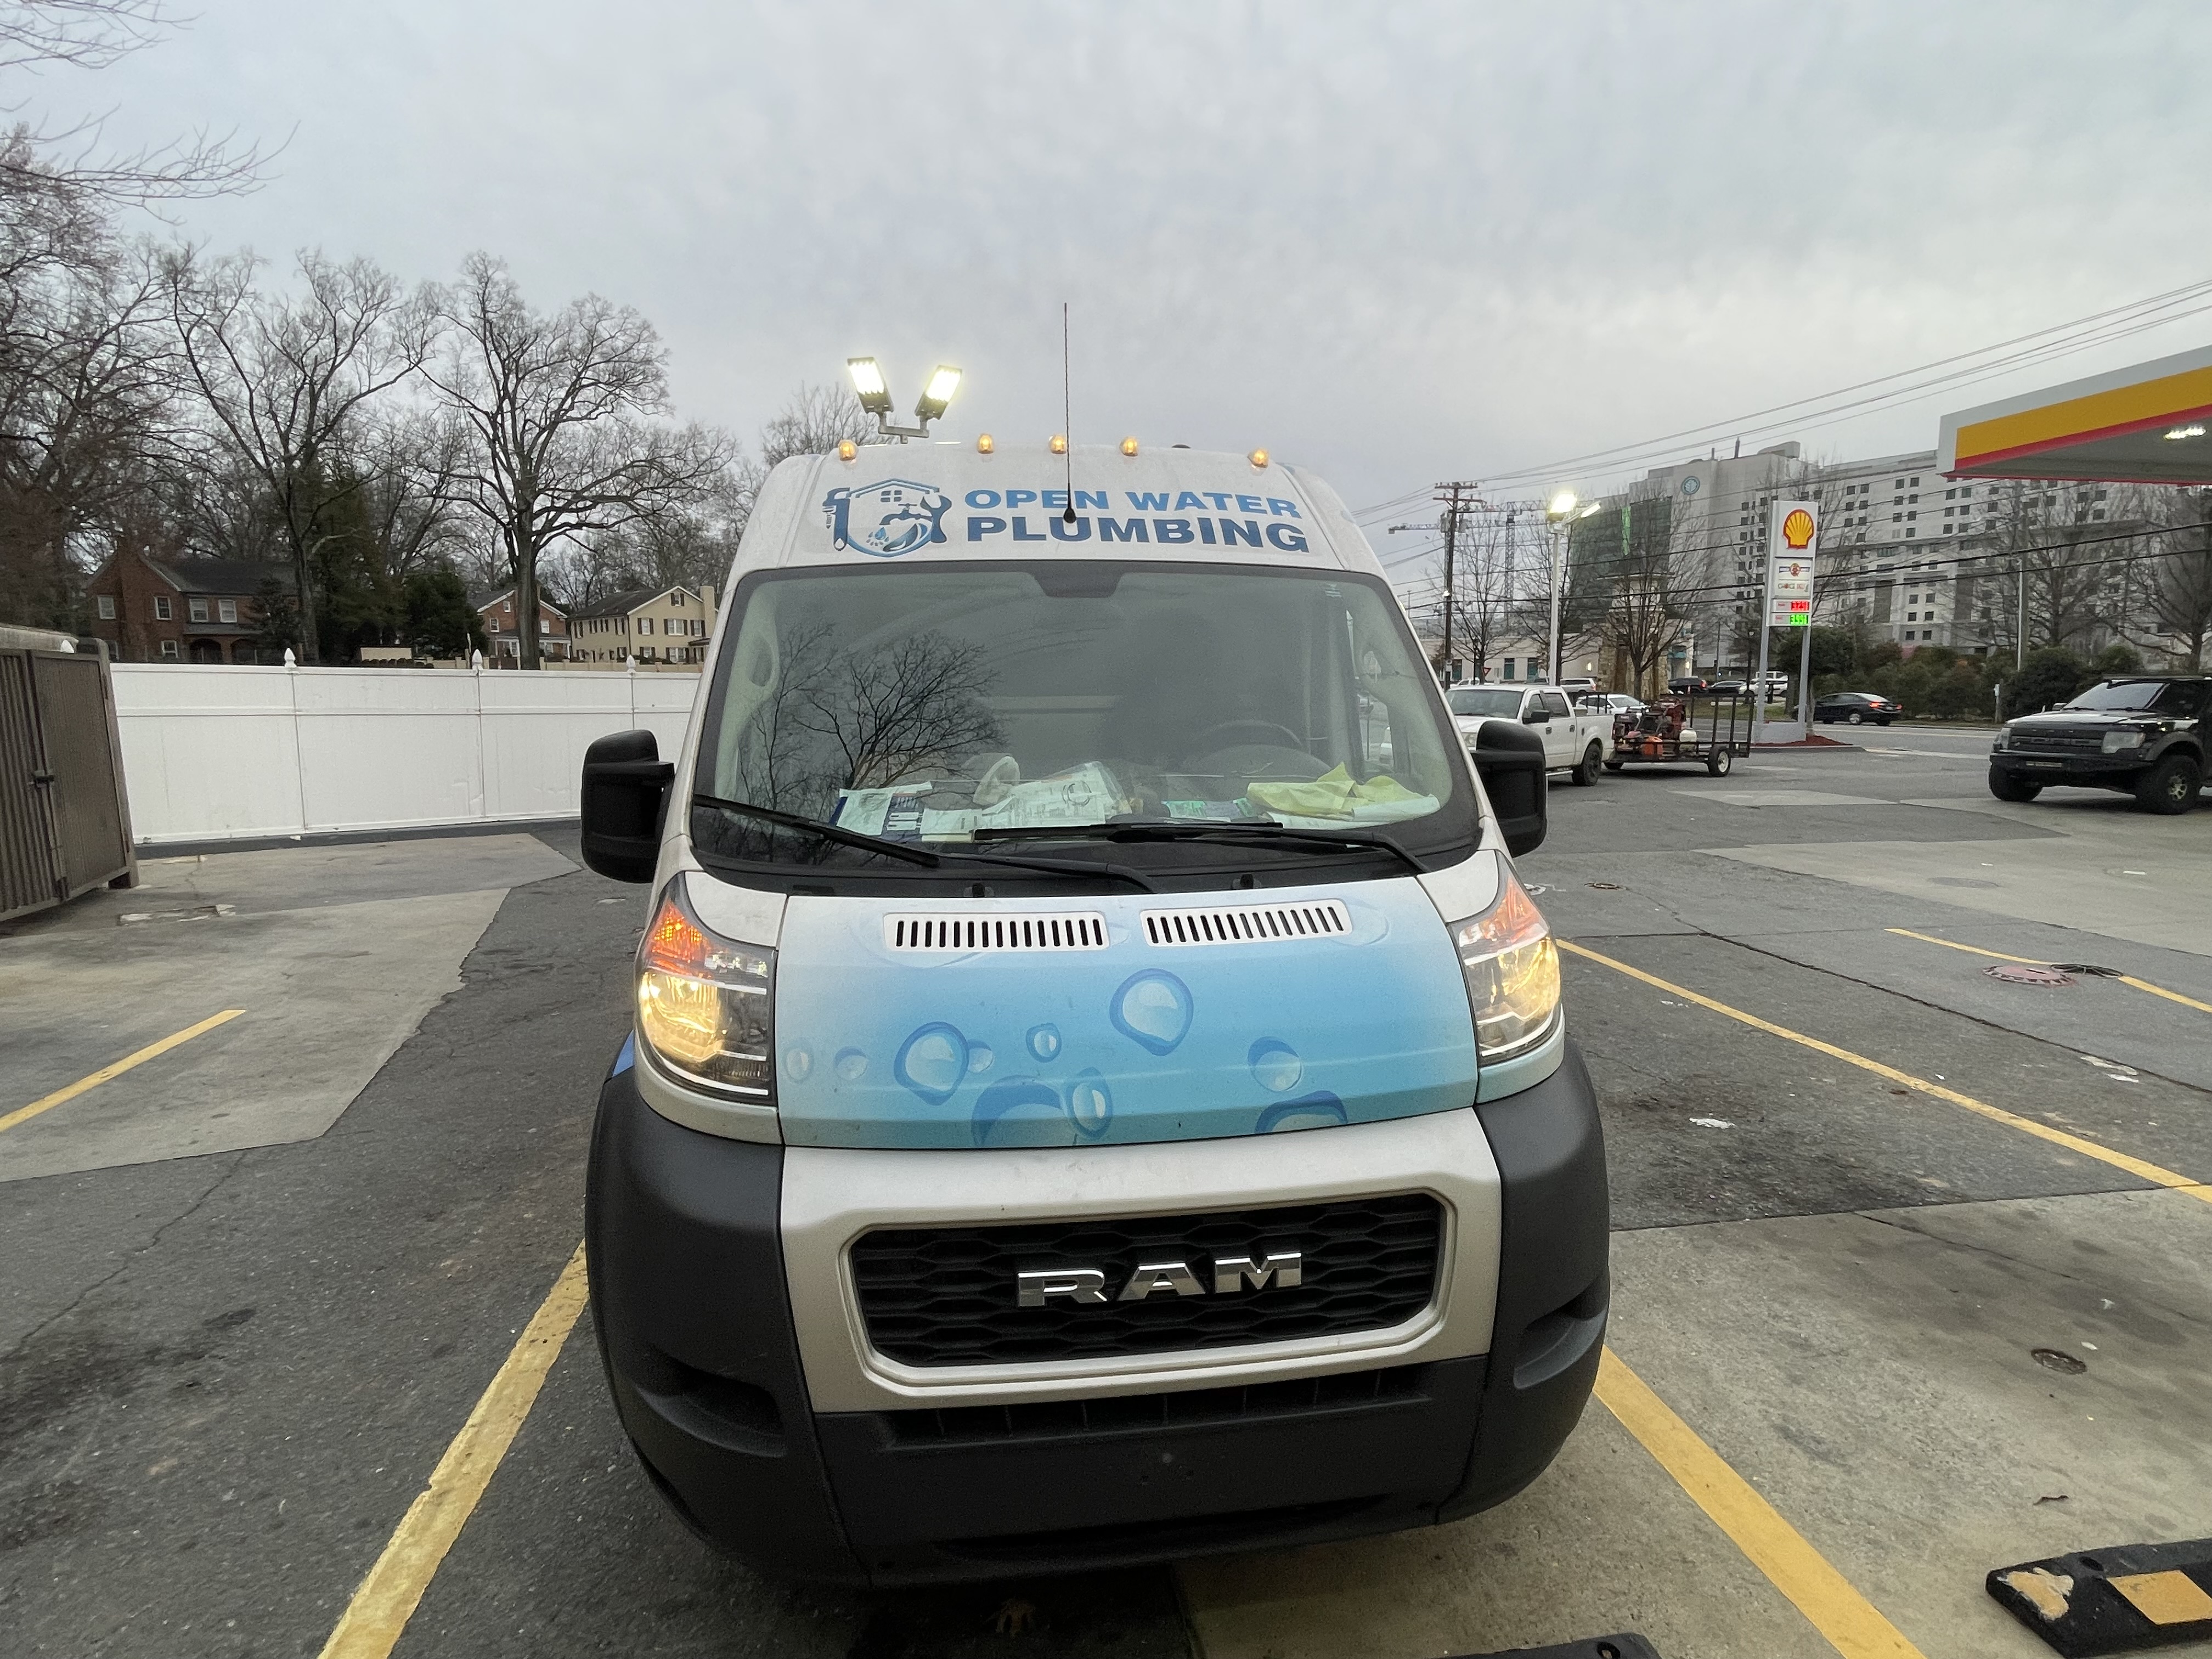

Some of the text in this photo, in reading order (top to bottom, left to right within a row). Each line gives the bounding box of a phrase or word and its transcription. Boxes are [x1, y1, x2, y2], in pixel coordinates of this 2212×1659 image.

[964, 489, 1302, 519] OPEN WATER
[967, 517, 1310, 553] PLUMBING
[1018, 1252, 1301, 1307] RAM
